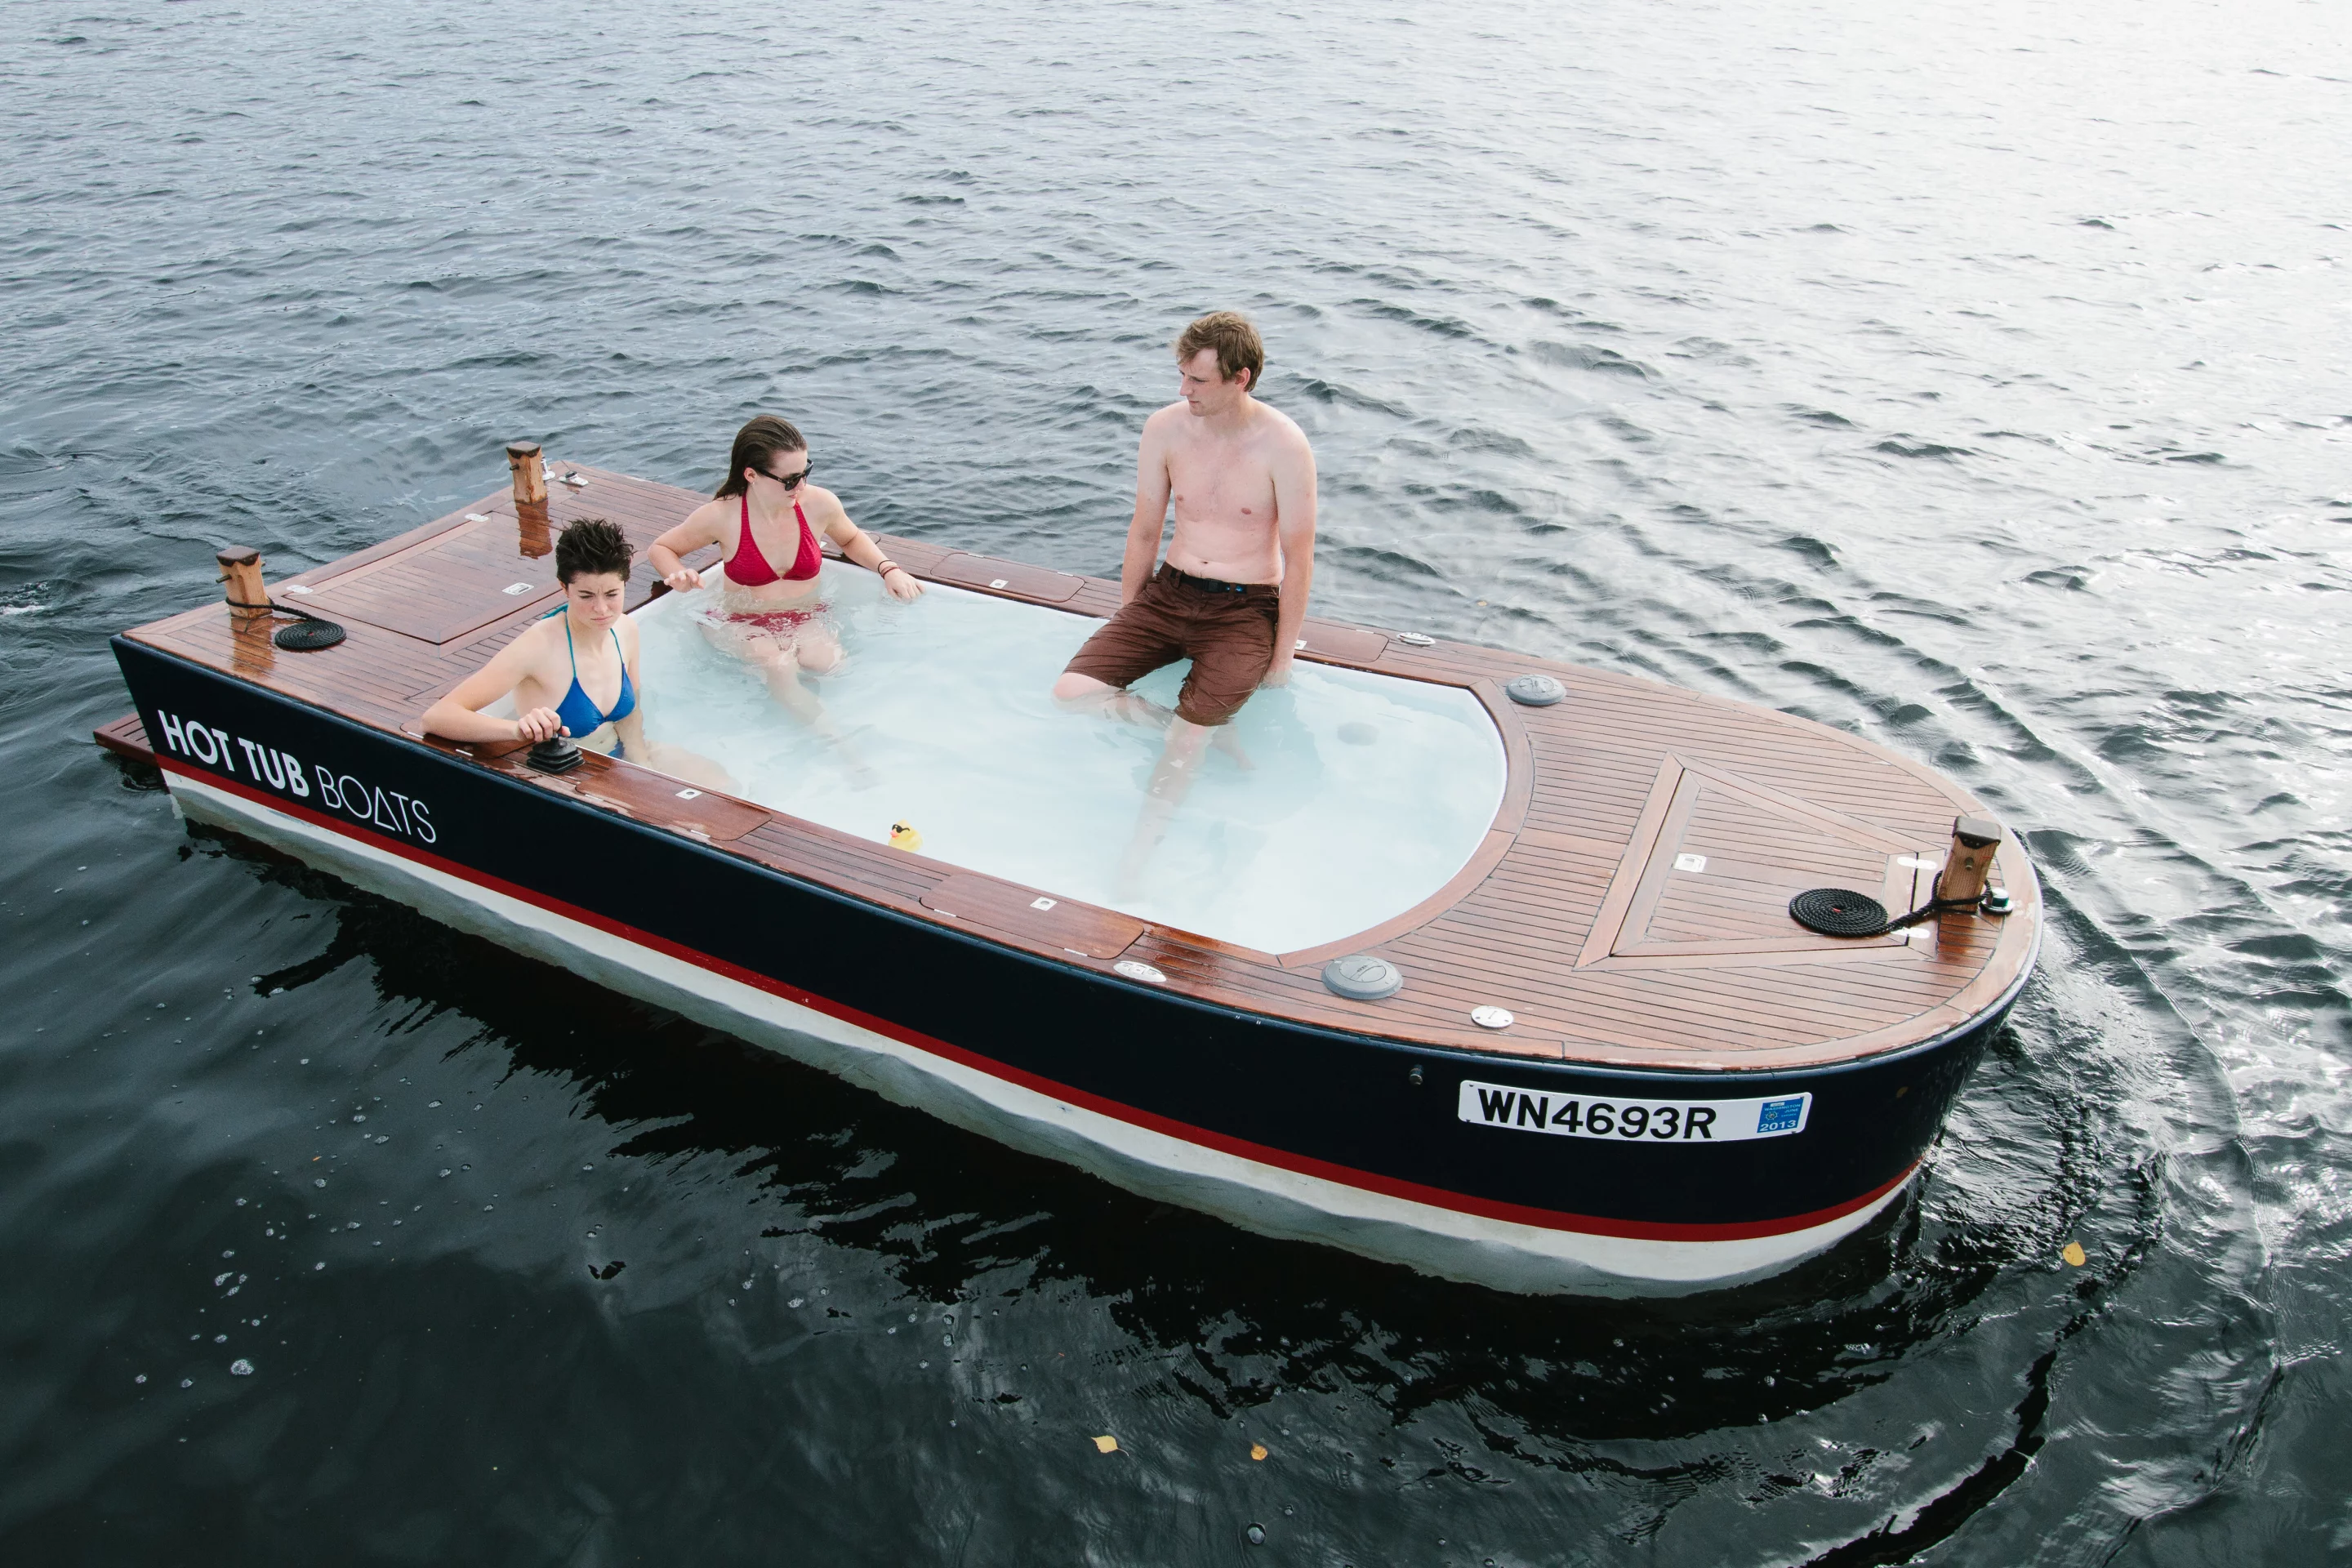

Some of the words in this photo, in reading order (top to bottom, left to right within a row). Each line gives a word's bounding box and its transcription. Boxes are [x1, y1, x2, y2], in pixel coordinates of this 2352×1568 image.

[158, 709, 235, 772] HOT
[238, 737, 310, 797] TUB
[315, 764, 437, 844] BOATS
[1477, 1088, 1717, 1140] WN4693R
[1759, 1120, 1797, 1132] 2013
